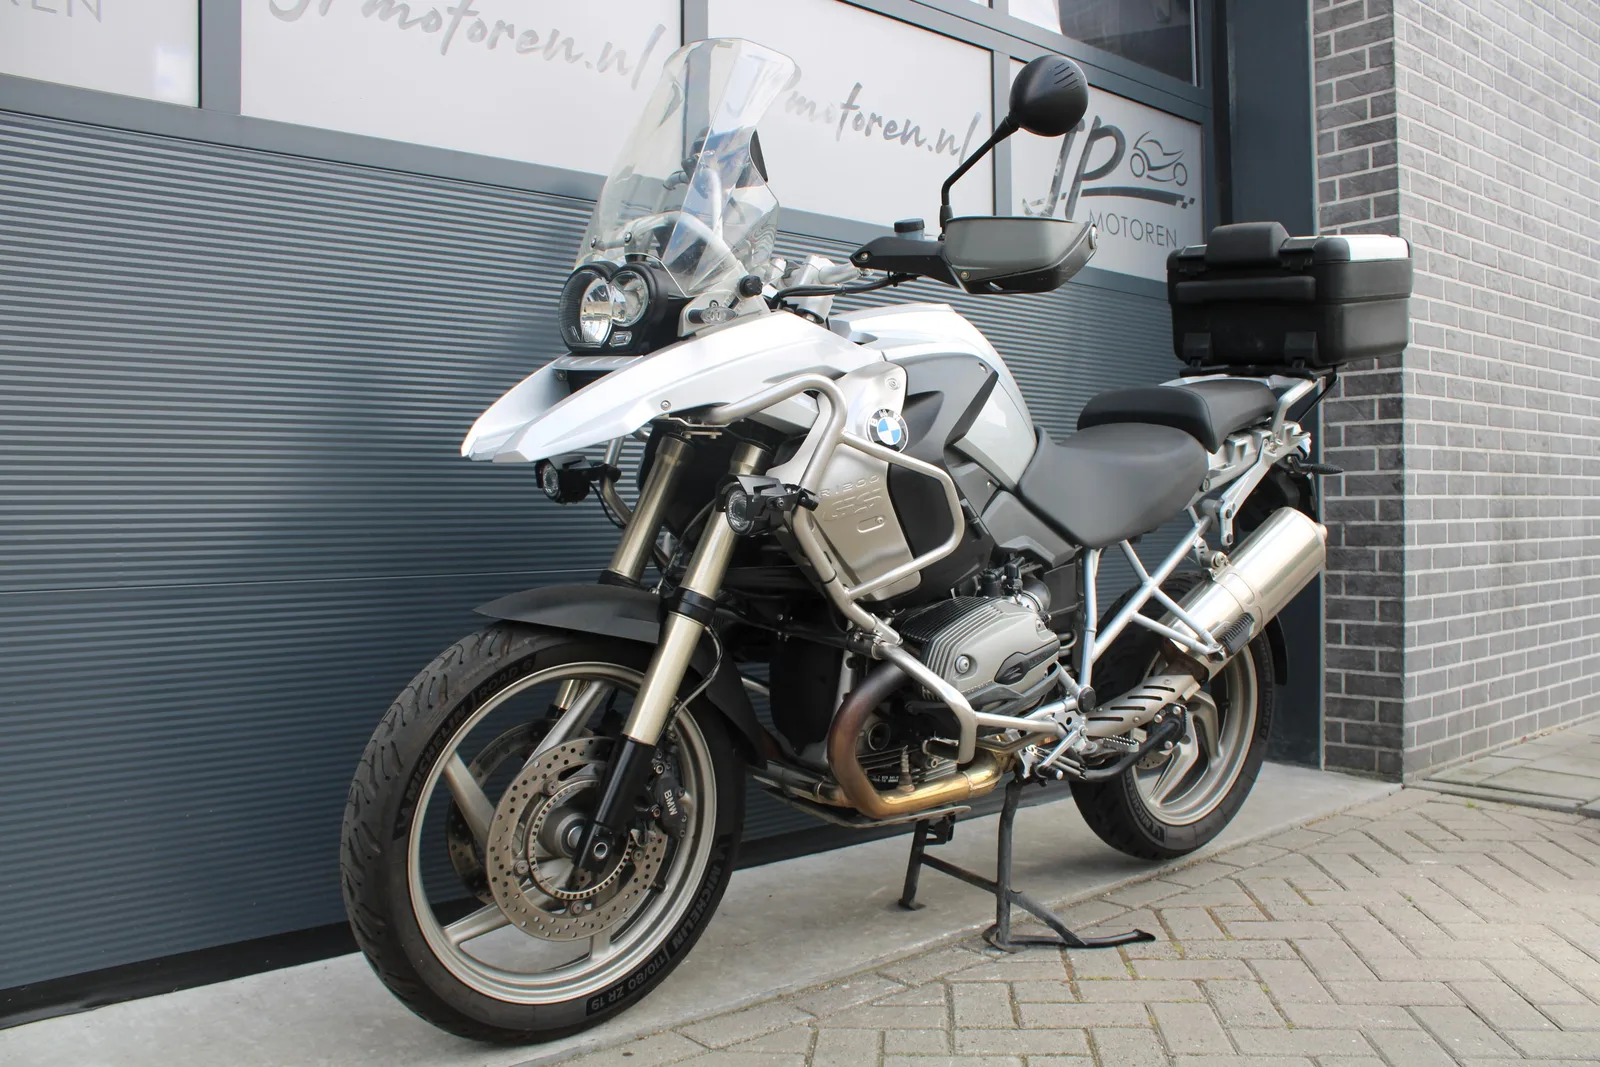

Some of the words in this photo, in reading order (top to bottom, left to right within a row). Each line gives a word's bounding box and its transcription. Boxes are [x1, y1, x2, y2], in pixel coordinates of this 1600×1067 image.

[269, 0, 667, 91] motoren.nl
[1089, 209, 1177, 248] MOTOREN
[406, 703, 468, 801] MICHELIN
[479, 665, 519, 700] ROAD
[664, 790, 678, 815] BMW
[671, 866, 722, 950] MICHELIN
[627, 953, 667, 989] 110/80
[591, 997, 605, 1011] 19
[608, 986, 625, 1003] ZR
